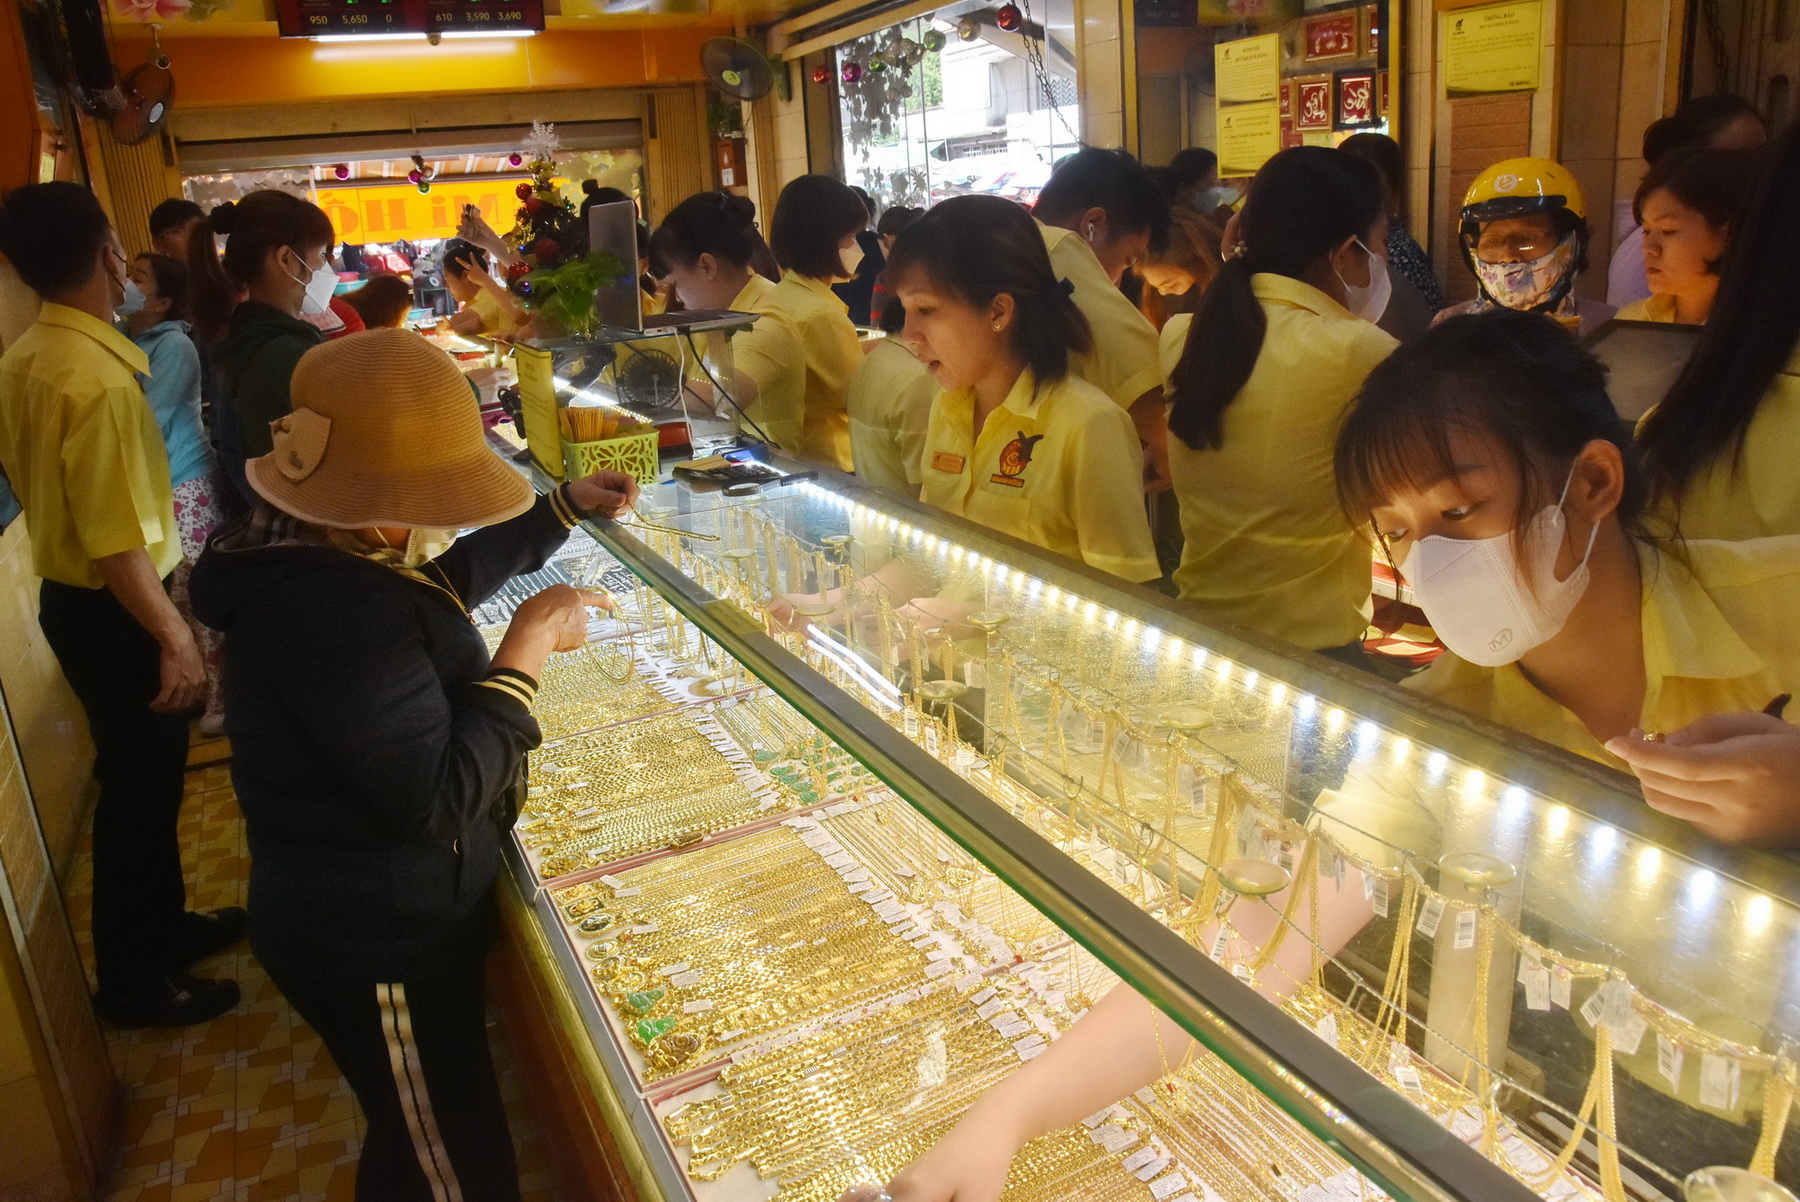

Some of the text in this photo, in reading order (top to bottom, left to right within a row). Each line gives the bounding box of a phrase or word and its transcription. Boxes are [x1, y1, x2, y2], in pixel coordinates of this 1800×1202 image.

[309, 11, 522, 25] 950 5,650 0 610 3,590 3,690
